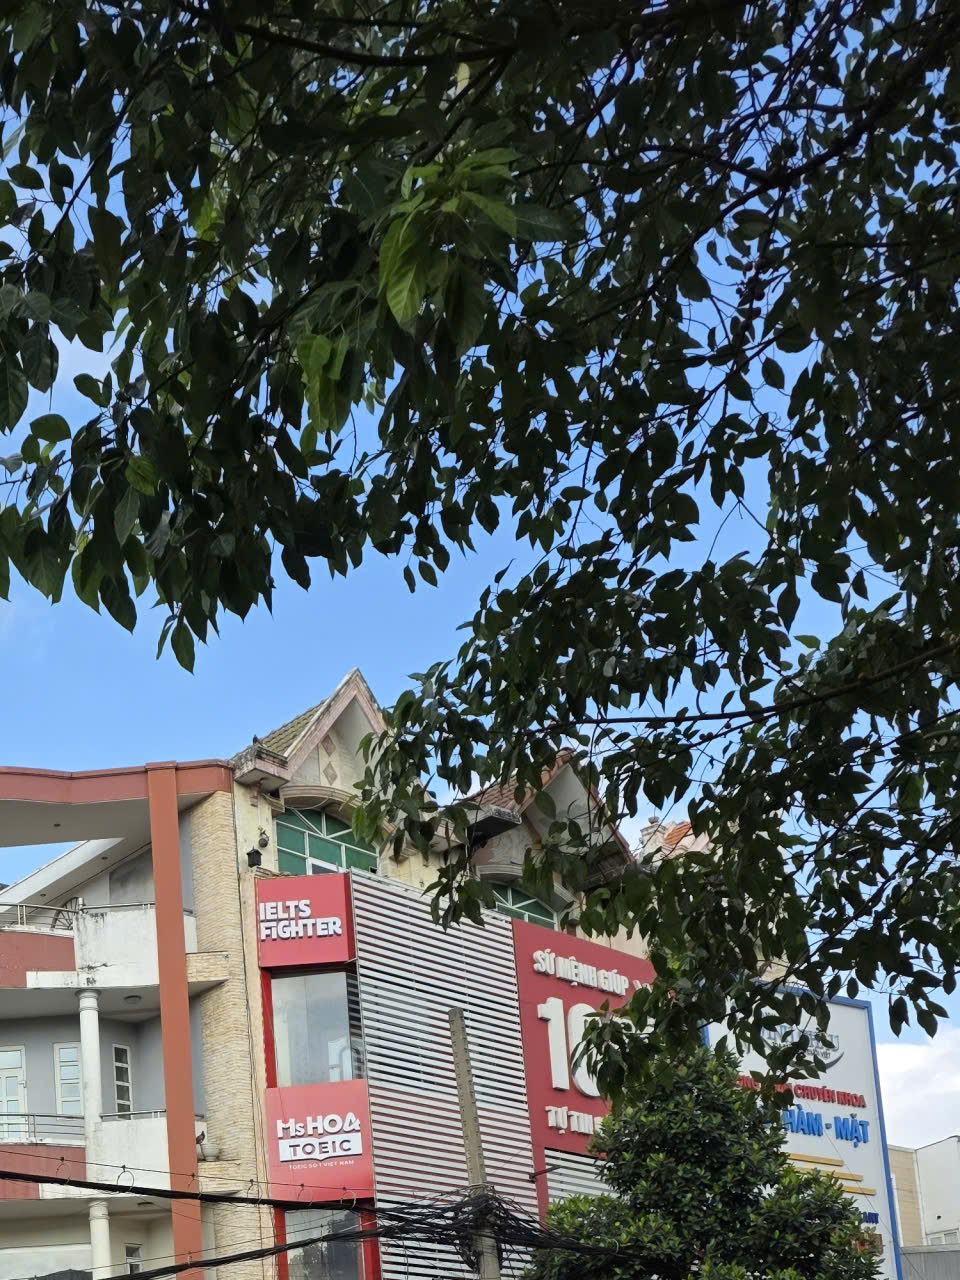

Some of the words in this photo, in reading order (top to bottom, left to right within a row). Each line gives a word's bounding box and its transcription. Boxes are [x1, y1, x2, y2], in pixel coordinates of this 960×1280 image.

[259, 900, 311, 921] IELTS
[260, 917, 342, 941] FIGHTER
[555, 956, 597, 987] MỆNH
[597, 969, 629, 996] GIÚP
[837, 1091, 867, 1108] KHOA
[545, 1106, 569, 1134] TỰ
[568, 1110, 594, 1135] TIN
[834, 1113, 870, 1148] MẶT
[289, 1140, 352, 1157] TOEIC
